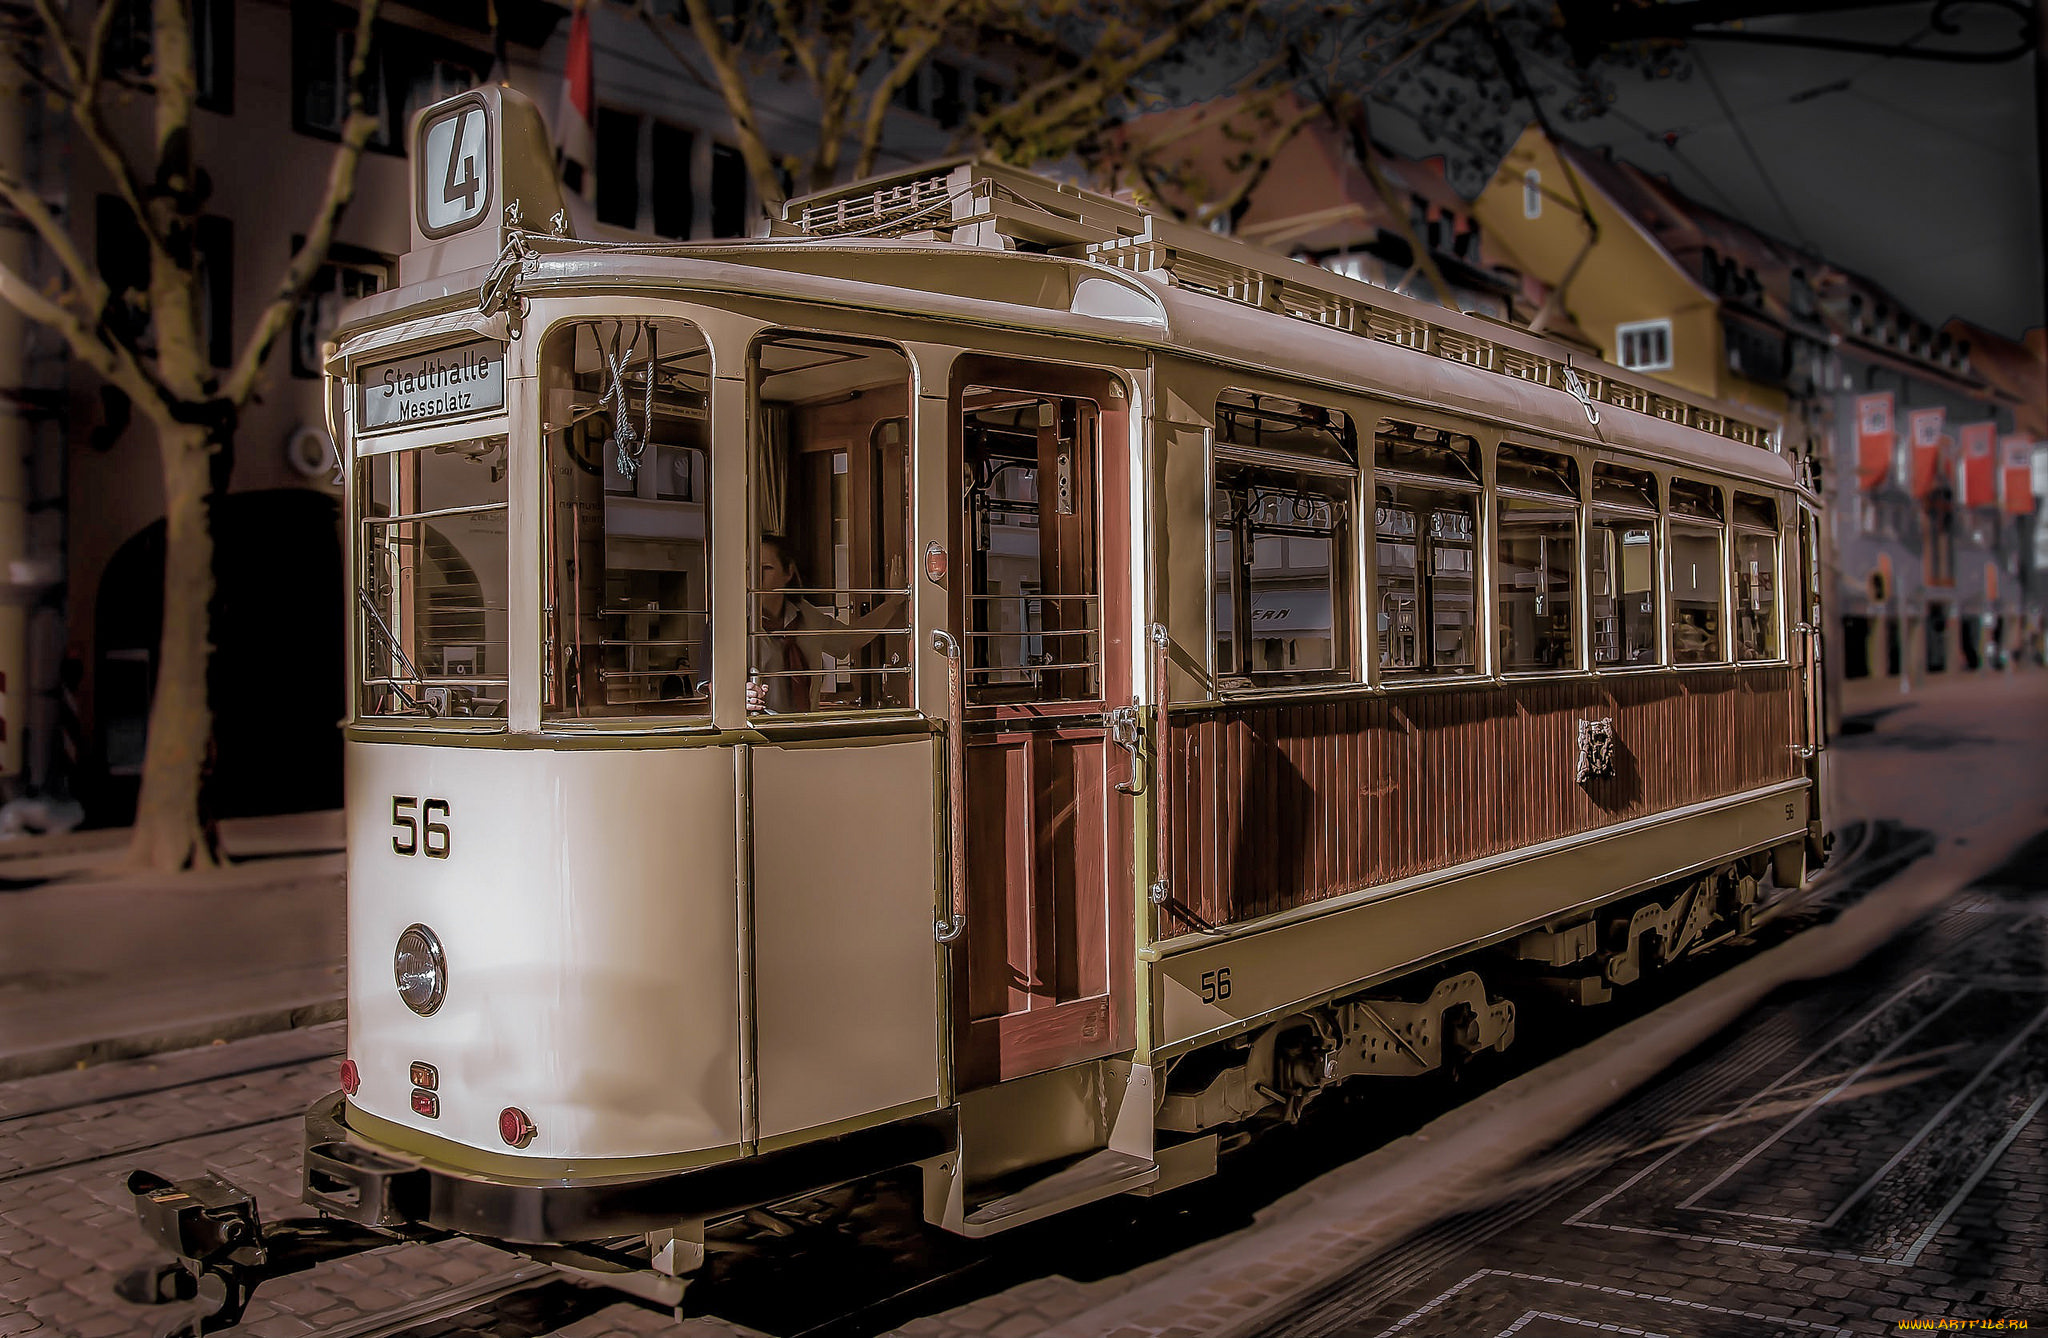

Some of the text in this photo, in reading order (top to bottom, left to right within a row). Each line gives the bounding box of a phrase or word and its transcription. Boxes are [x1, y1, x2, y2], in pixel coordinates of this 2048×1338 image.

[444, 111, 479, 211] 4
[383, 351, 489, 398] Stadthalle
[400, 391, 471, 421] Messplatz
[392, 795, 450, 859] 56
[1785, 803, 1794, 820] 56
[1201, 967, 1232, 1004] 56
